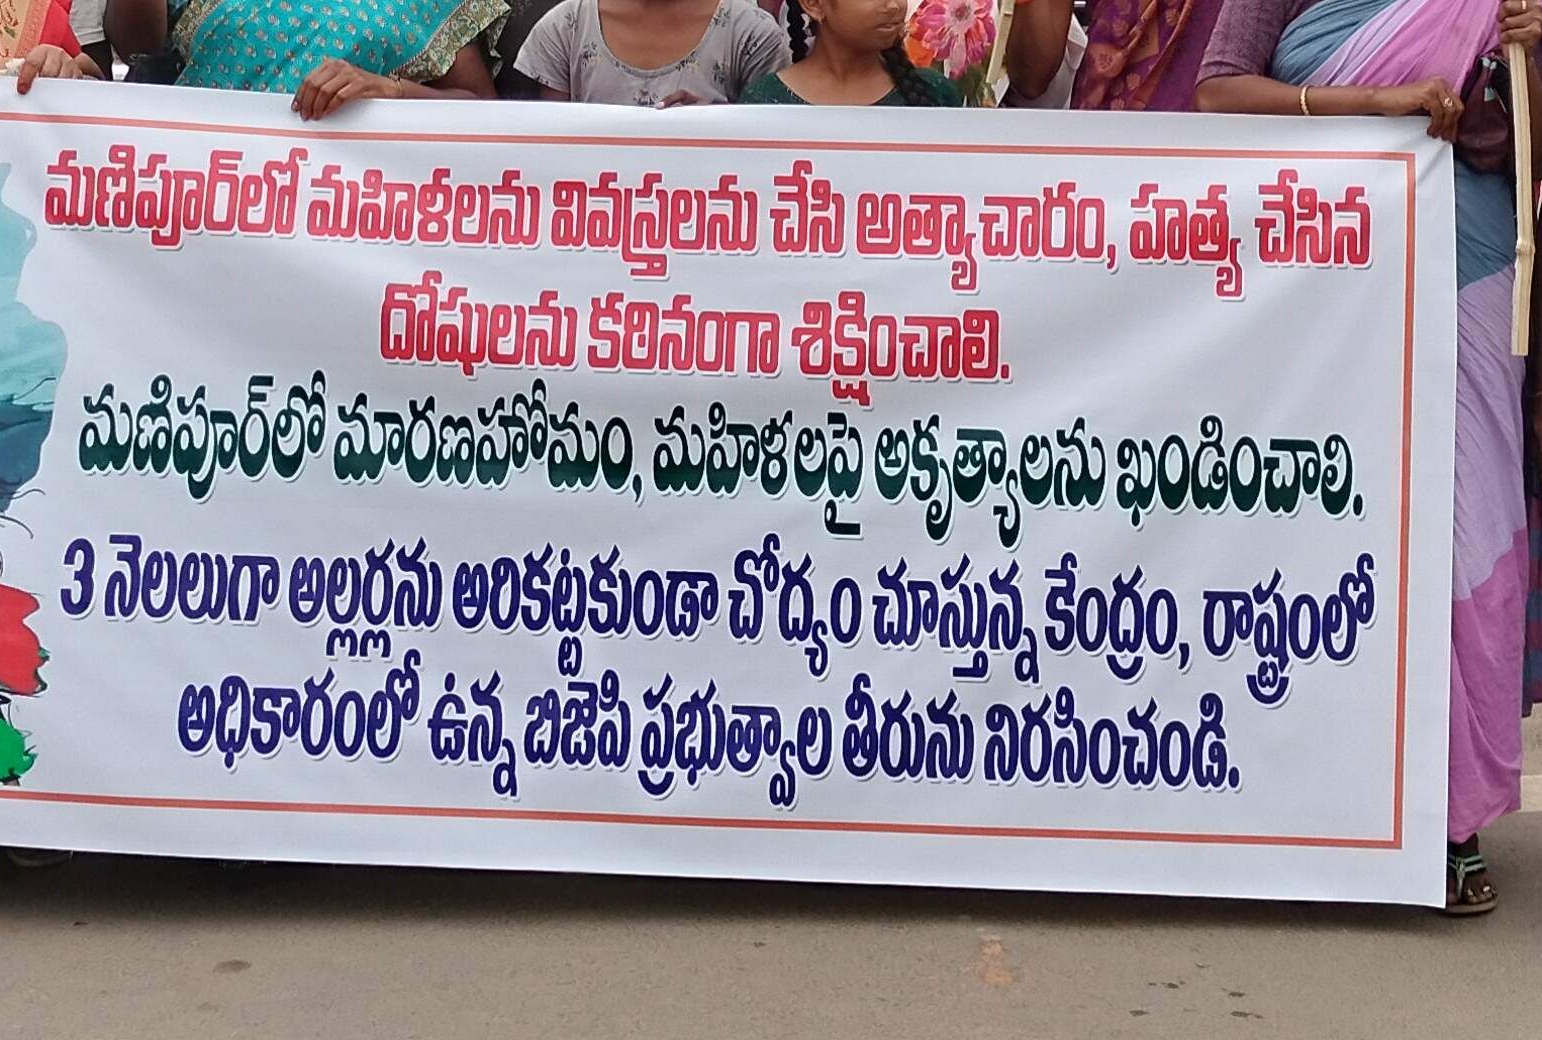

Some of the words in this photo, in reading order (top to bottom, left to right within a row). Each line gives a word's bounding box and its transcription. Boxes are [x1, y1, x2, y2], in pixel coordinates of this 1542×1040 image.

[44, 144, 307, 248] మణిపూర్‌లో
[307, 167, 541, 248] మహిళలను
[551, 173, 759, 277] వివస్త్రలను
[769, 160, 847, 259] చేసి
[856, 181, 1117, 291] అత్యాచారం,
[1129, 182, 1243, 298] హత్య
[1253, 168, 1374, 268] చేసిన
[380, 270, 576, 377] దోషులను
[587, 290, 780, 376] కఠినంగా
[790, 291, 1011, 407] శిక్షించాలి.
[77, 369, 327, 501] మణిపూర్‌లో
[332, 379, 643, 503] మారణహోమం,
[651, 401, 863, 537] మహిళలపై
[874, 415, 1107, 549] అకృత్యాలను
[1115, 416, 1365, 529] ఖండించాలి.
[59, 537, 97, 619] 3
[103, 533, 280, 625] నెలలుగా
[287, 537, 445, 658] అల్లర్లను
[451, 543, 718, 677] అరికట్టకుండా
[728, 533, 862, 679] చోద్యం
[871, 554, 1041, 687] చూస్తున్న
[1044, 552, 1191, 681] కేంద్రం,
[1201, 552, 1376, 707] రాష్ట్రంలో
[177, 648, 423, 771] అధికారంలో
[427, 670, 520, 799] ఉన్న
[524, 672, 631, 771] బిజెపి
[637, 673, 834, 811] ప్రభుత్వాల
[842, 672, 976, 785] తీరును
[984, 686, 1242, 792] నిరసించండి.
